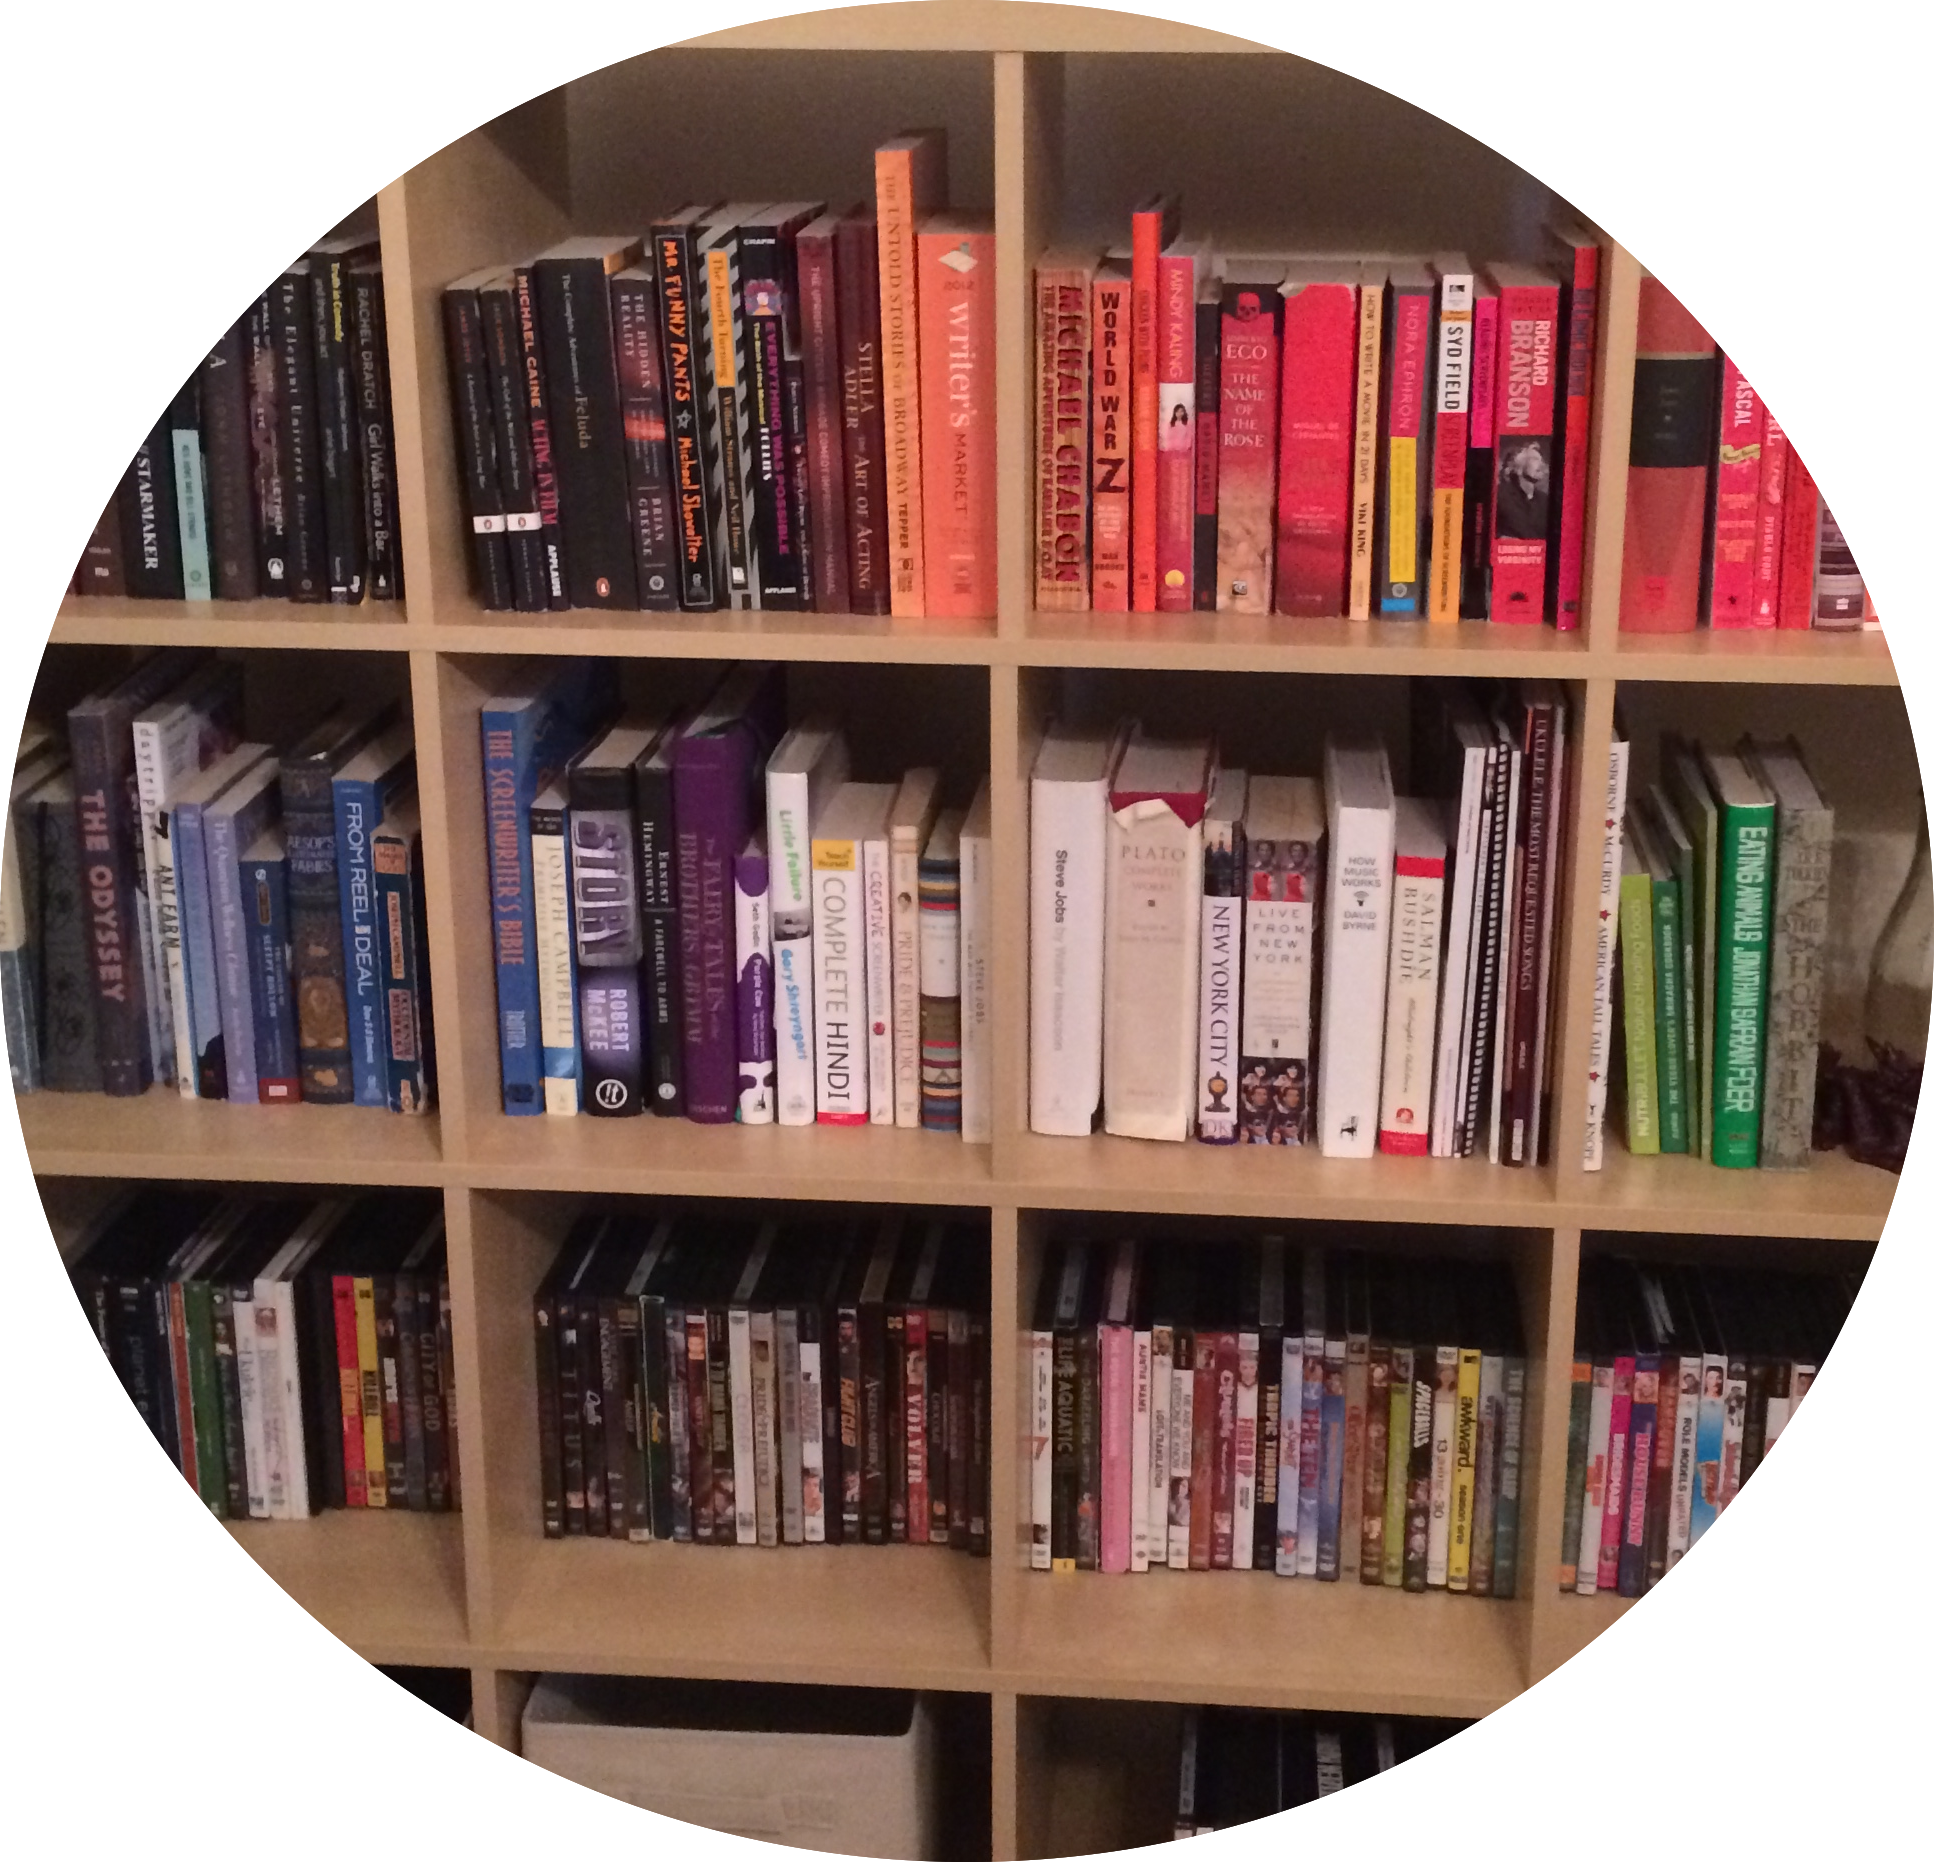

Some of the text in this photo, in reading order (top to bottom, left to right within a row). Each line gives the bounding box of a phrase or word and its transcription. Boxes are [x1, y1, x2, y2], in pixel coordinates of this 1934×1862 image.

[517, 275, 542, 410] MICHAEL CAINE
[620, 294, 635, 359] REALITY
[633, 294, 653, 390] THE HIDDEN
[712, 258, 730, 379] The Fourth Turning
[1100, 292, 1120, 387] WORLD
[1169, 269, 1184, 379] MINDY KALING
[1225, 344, 1268, 361] ECO
[1403, 304, 1418, 354] NORA
[1532, 319, 1551, 387] RICHARD
[357, 287, 384, 489] RACHEL DRATCH Girl Walks
[844, 364, 860, 429] ADLER
[858, 342, 875, 413] STELLA
[886, 205, 909, 549] UNTOLD STORIES BROADWAY TEPPER
[1223, 388, 1267, 402] NAME
[1231, 373, 1259, 386] THE
[1399, 359, 1416, 431] EPHRON
[1444, 325, 1464, 410] SYD FIELD
[1505, 319, 1535, 429] BRANSON
[574, 395, 592, 449] Feluda
[664, 274, 702, 563] FUNNY PANTS Michael Showalter
[765, 322, 791, 556] EVERYTHING WAS POSSIBLE
[948, 302, 977, 517] writer's MARKET
[1055, 285, 1082, 582] MICHAEL CHABON
[1100, 395, 1120, 451] WAR
[1223, 432, 1265, 449] ROSE
[1231, 418, 1258, 431] THE
[1234, 405, 1253, 417] OF
[1356, 294, 1377, 559] HOW TO WRITE MOVIE IN DAYS VIKI KING
[1096, 456, 1126, 494] Z
[137, 457, 160, 571] STARMAKER
[638, 497, 652, 558] GREENE
[651, 496, 665, 542] BRIAN
[853, 454, 873, 590] ART OF ACTING
[546, 543, 562, 598] APPLAUSE
[346, 801, 365, 864] FROM
[488, 729, 525, 966] THE SCREENWRITER'S BIBLE
[642, 820, 655, 905] HEMINGWAY
[779, 810, 797, 849] Little
[1121, 846, 1187, 862] PLATO
[1348, 857, 1376, 866] HOW
[80, 788, 127, 1003] THE ODYSSEY
[350, 867, 370, 923] REEL
[545, 847, 568, 921] JOSEPH
[574, 820, 631, 956] STORY
[658, 850, 670, 905] ERNEST
[786, 852, 802, 902] Failure
[870, 870, 885, 938] CREATIVE
[1054, 849, 1067, 888] Steve
[1341, 878, 1382, 888] WORKS
[1343, 867, 1379, 877] MUSIC
[1520, 791, 1543, 991] THE MOST REQUESTED SONGS
[159, 863, 182, 950] ANT FARM
[1054, 890, 1067, 924] Jobs
[1252, 924, 1305, 936] FROM
[1259, 908, 1300, 918] LIVE
[1342, 922, 1377, 932] BYRNE
[1343, 911, 1377, 920] DAVID
[1399, 886, 1418, 985] RUSHDIE
[1418, 891, 1435, 981] SALMAN
[1591, 753, 1620, 1068] OSBORNE AMERICAN TALES
[654, 927, 669, 1024] FAREWELL TO ARMS
[781, 949, 795, 983] Gary
[1054, 944, 1066, 987] Walter
[1254, 954, 1304, 964] YORK
[1259, 939, 1299, 949] NEW
[1724, 826, 1769, 1114] EATING ANIMALS JONATHAN SAFRAN FOER
[552, 931, 574, 1042] CAMPBELL
[587, 988, 609, 1052] McKEE
[609, 987, 630, 1053] ROBERT
[823, 877, 850, 1101] COMPLETE HINDI
[897, 930, 914, 1087] PRIDE PREJUDICE
[1210, 904, 1229, 1068] NEW YORK CITY
[420, 1332, 441, 1432] CITY GOD
[1137, 1343, 1148, 1414] AUNTIE MAME
[1264, 1383, 1280, 1437] TROPIC
[1412, 1380, 1432, 1448] SPACEBALLS
[1509, 1369, 1524, 1393] THE
[562, 1369, 583, 1471] TITUS
[907, 1392, 923, 1484] VOLVER
[1056, 1380, 1075, 1454] AQUATIC
[1172, 1375, 1182, 1470] EVERYONE WE KNOW
[1182, 1393, 1192, 1470] ME AND YOU AND
[1300, 1406, 1320, 1489] THE TEN
[1433, 1438, 1449, 1520] 13 30
[1456, 1395, 1477, 1545] awkward. season one
[1678, 1416, 1695, 1492] ROLE MODELS
